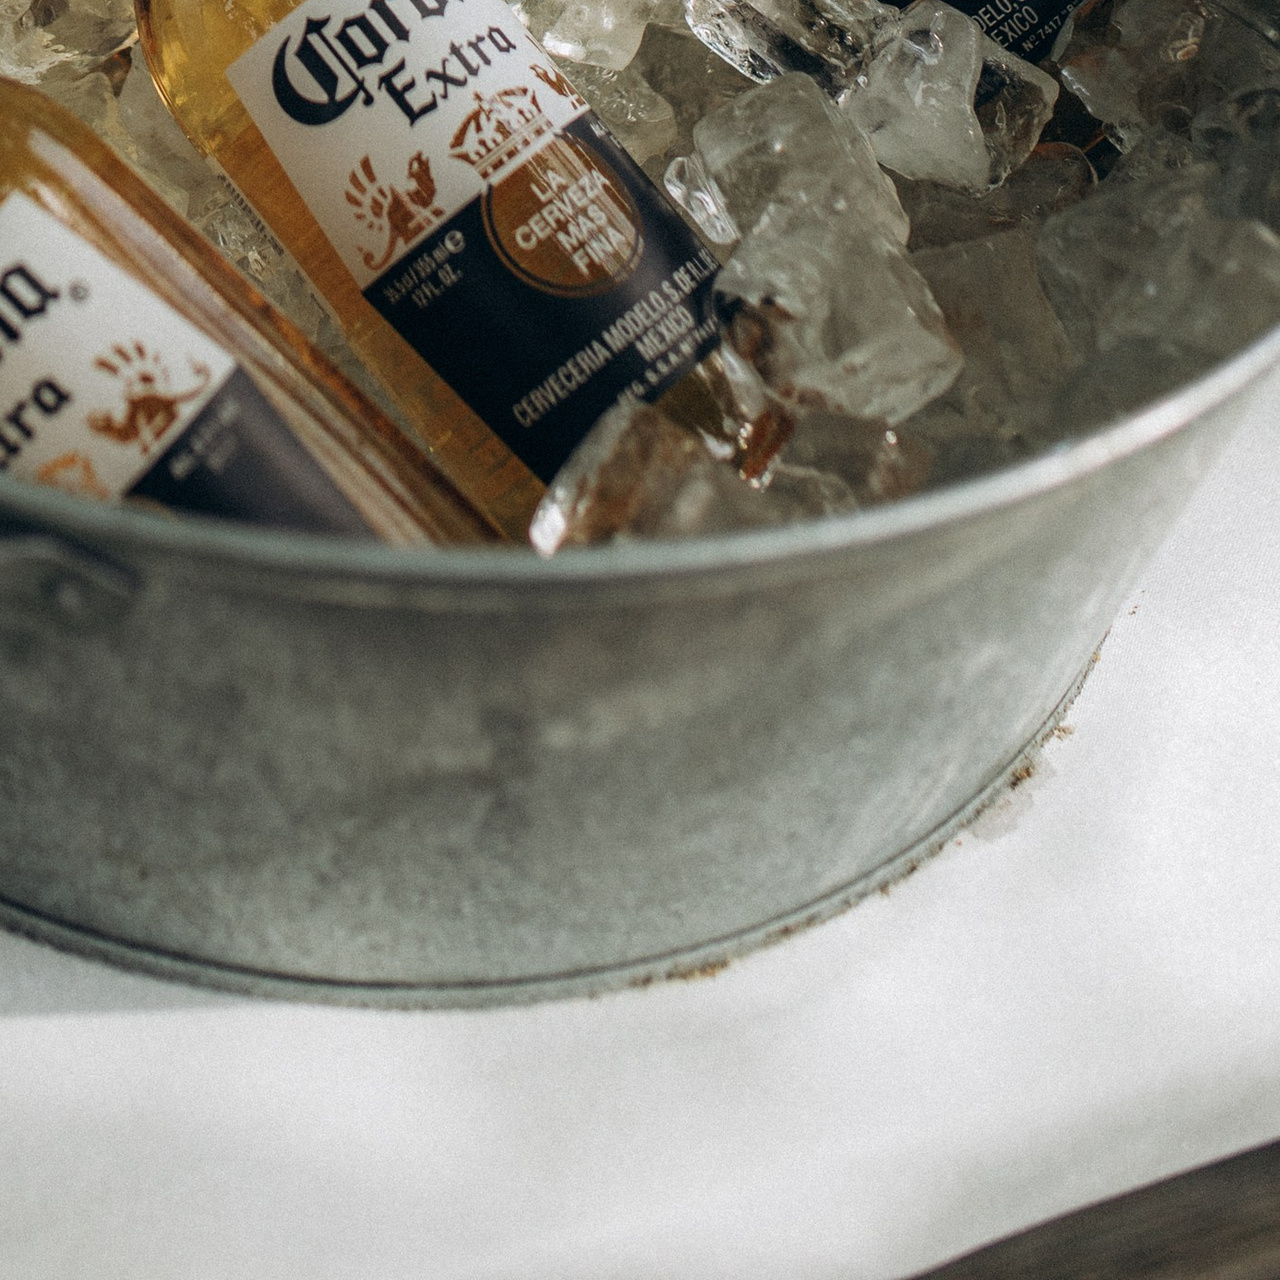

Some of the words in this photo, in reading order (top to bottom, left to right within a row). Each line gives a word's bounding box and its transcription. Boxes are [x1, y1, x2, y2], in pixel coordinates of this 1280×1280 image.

[990, 5, 1039, 48] EXICO
[378, 25, 517, 127] Extra
[515, 168, 611, 250] CERVEZA
[530, 169, 567, 203] LA
[556, 203, 608, 254] MAS
[572, 226, 627, 278] FINA
[635, 304, 695, 362] MEXICO
[513, 341, 612, 428] CERVECERIA
